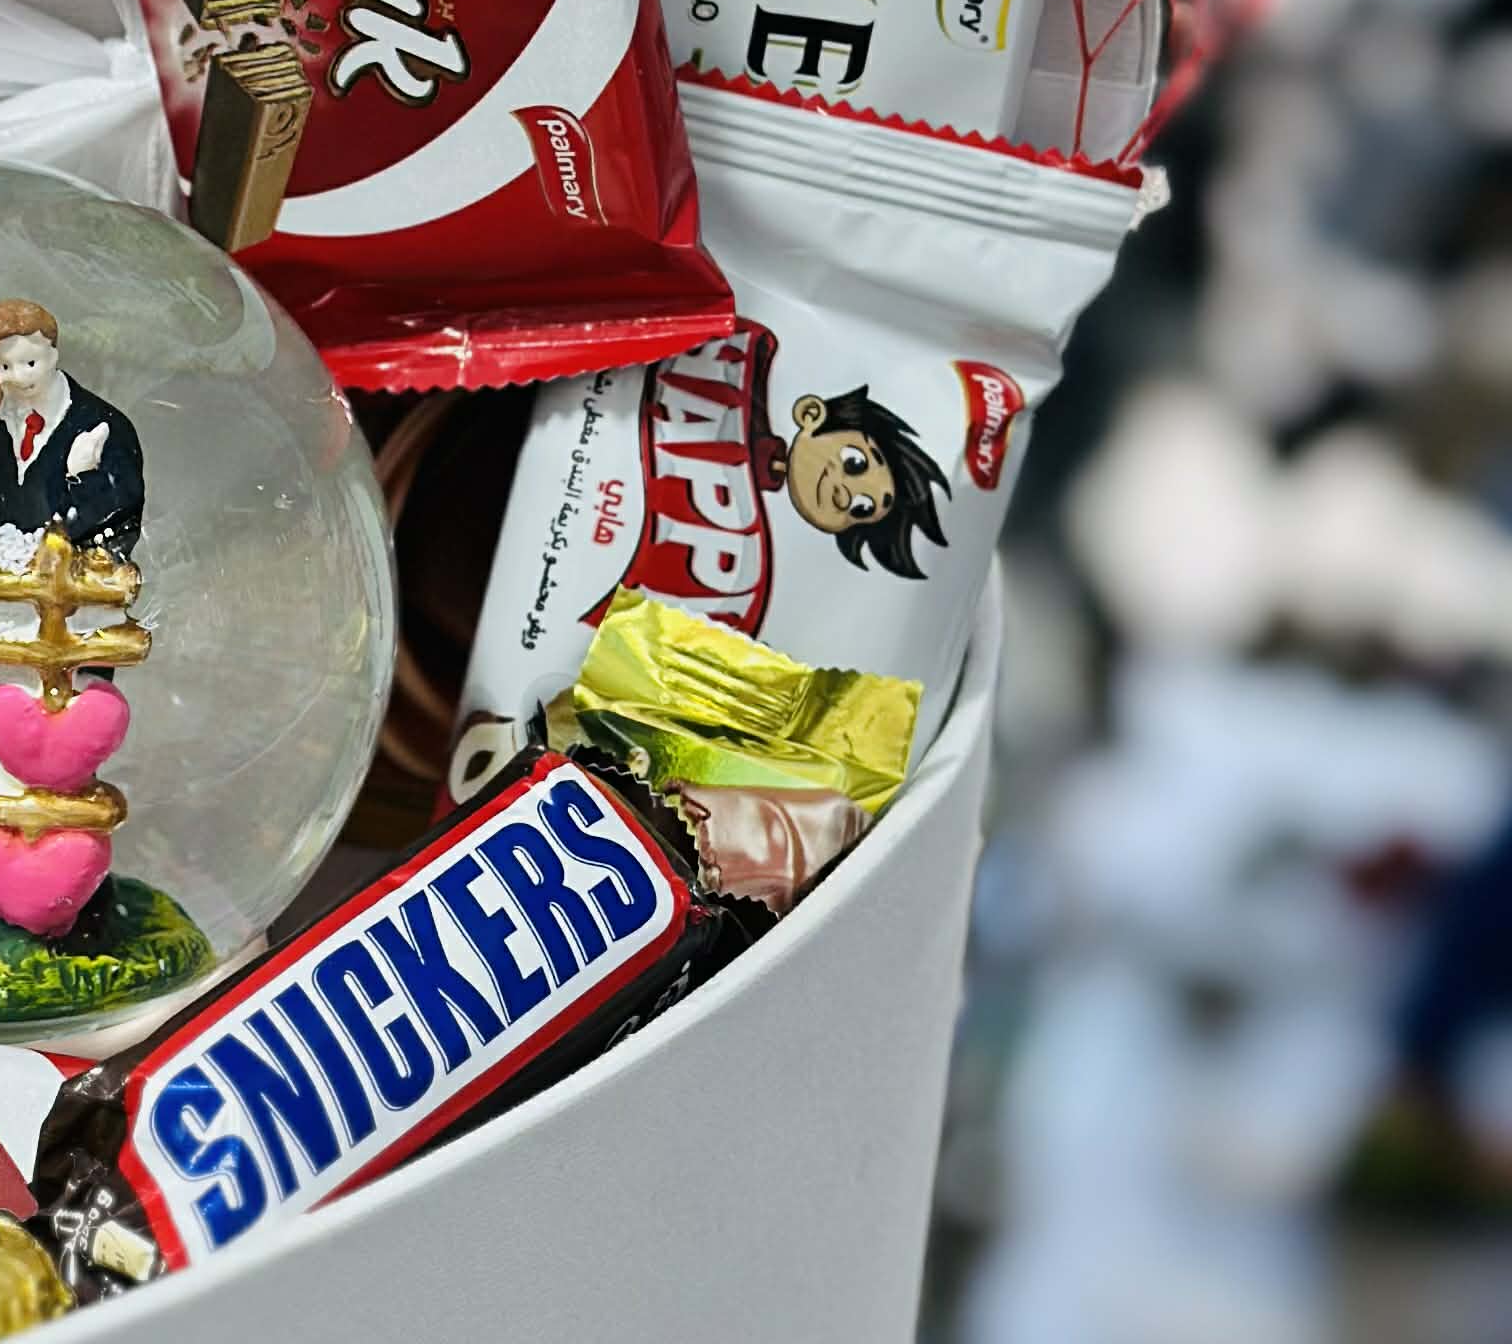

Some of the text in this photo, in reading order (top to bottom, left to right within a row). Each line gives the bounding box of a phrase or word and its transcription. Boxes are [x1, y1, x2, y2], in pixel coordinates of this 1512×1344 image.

[536, 119, 588, 218] palmary
[564, 449, 592, 501] البندق
[651, 332, 764, 618] HAPP
[971, 374, 1009, 476] palmary
[593, 479, 625, 547] هابي
[150, 780, 657, 1250] SNICKERS
